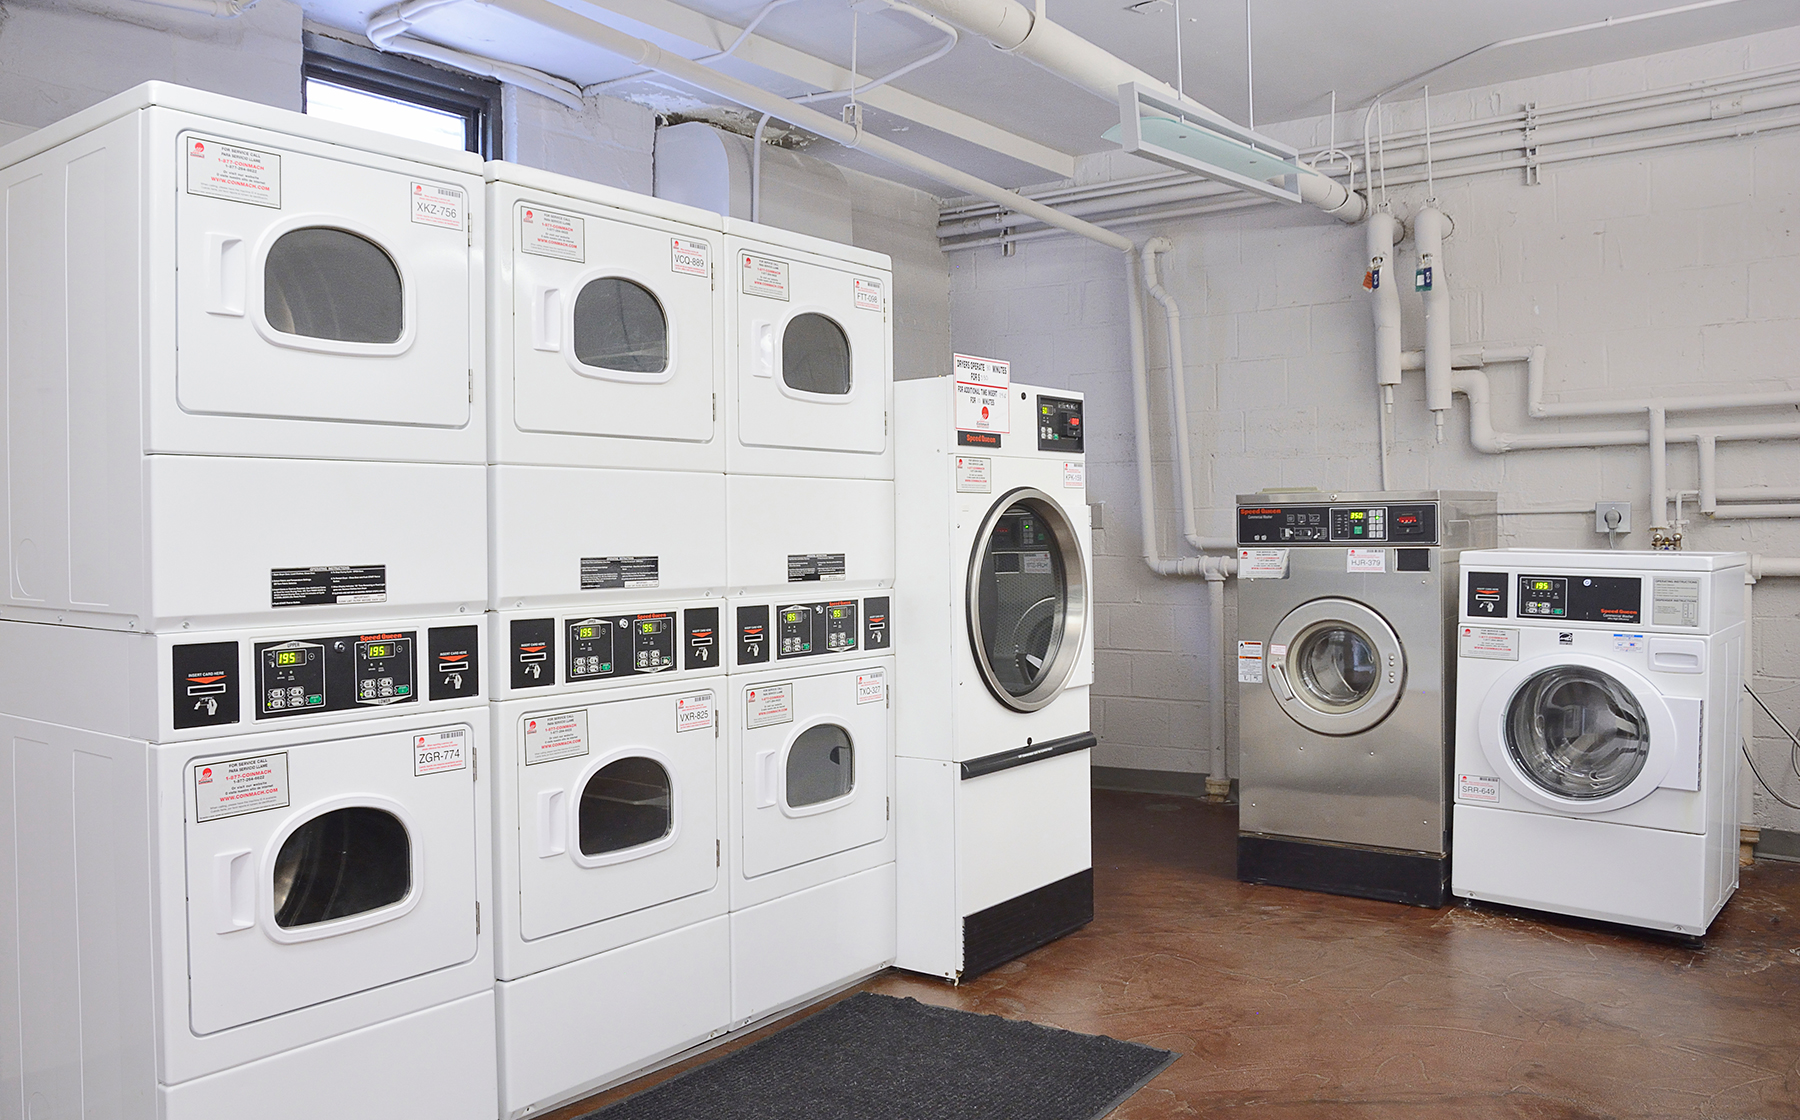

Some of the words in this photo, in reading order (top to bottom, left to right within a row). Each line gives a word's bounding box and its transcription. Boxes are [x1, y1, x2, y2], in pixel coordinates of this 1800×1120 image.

[218, 158, 264, 170] 1-877-COINMACH
[211, 176, 270, 191] WWW.COINMACH.COM
[417, 202, 456, 218] XKZ-756
[674, 254, 704, 267] VCQ-889
[957, 360, 970, 369] DRYERS
[971, 362, 985, 371] OPERATE
[992, 365, 1007, 374] MINUTES
[966, 434, 981, 442] Speed
[982, 435, 996, 443] Queen
[360, 634, 380, 642] Speed
[370, 646, 385, 656] 195
[279, 652, 295, 664] 195
[680, 710, 708, 722] VXR-825
[419, 749, 460, 764] ZGR-774
[226, 769, 272, 780] 1-877-COINMACH
[220, 788, 278, 802] WWW.COINMACH.COM
[1462, 786, 1495, 795] SRR-649
